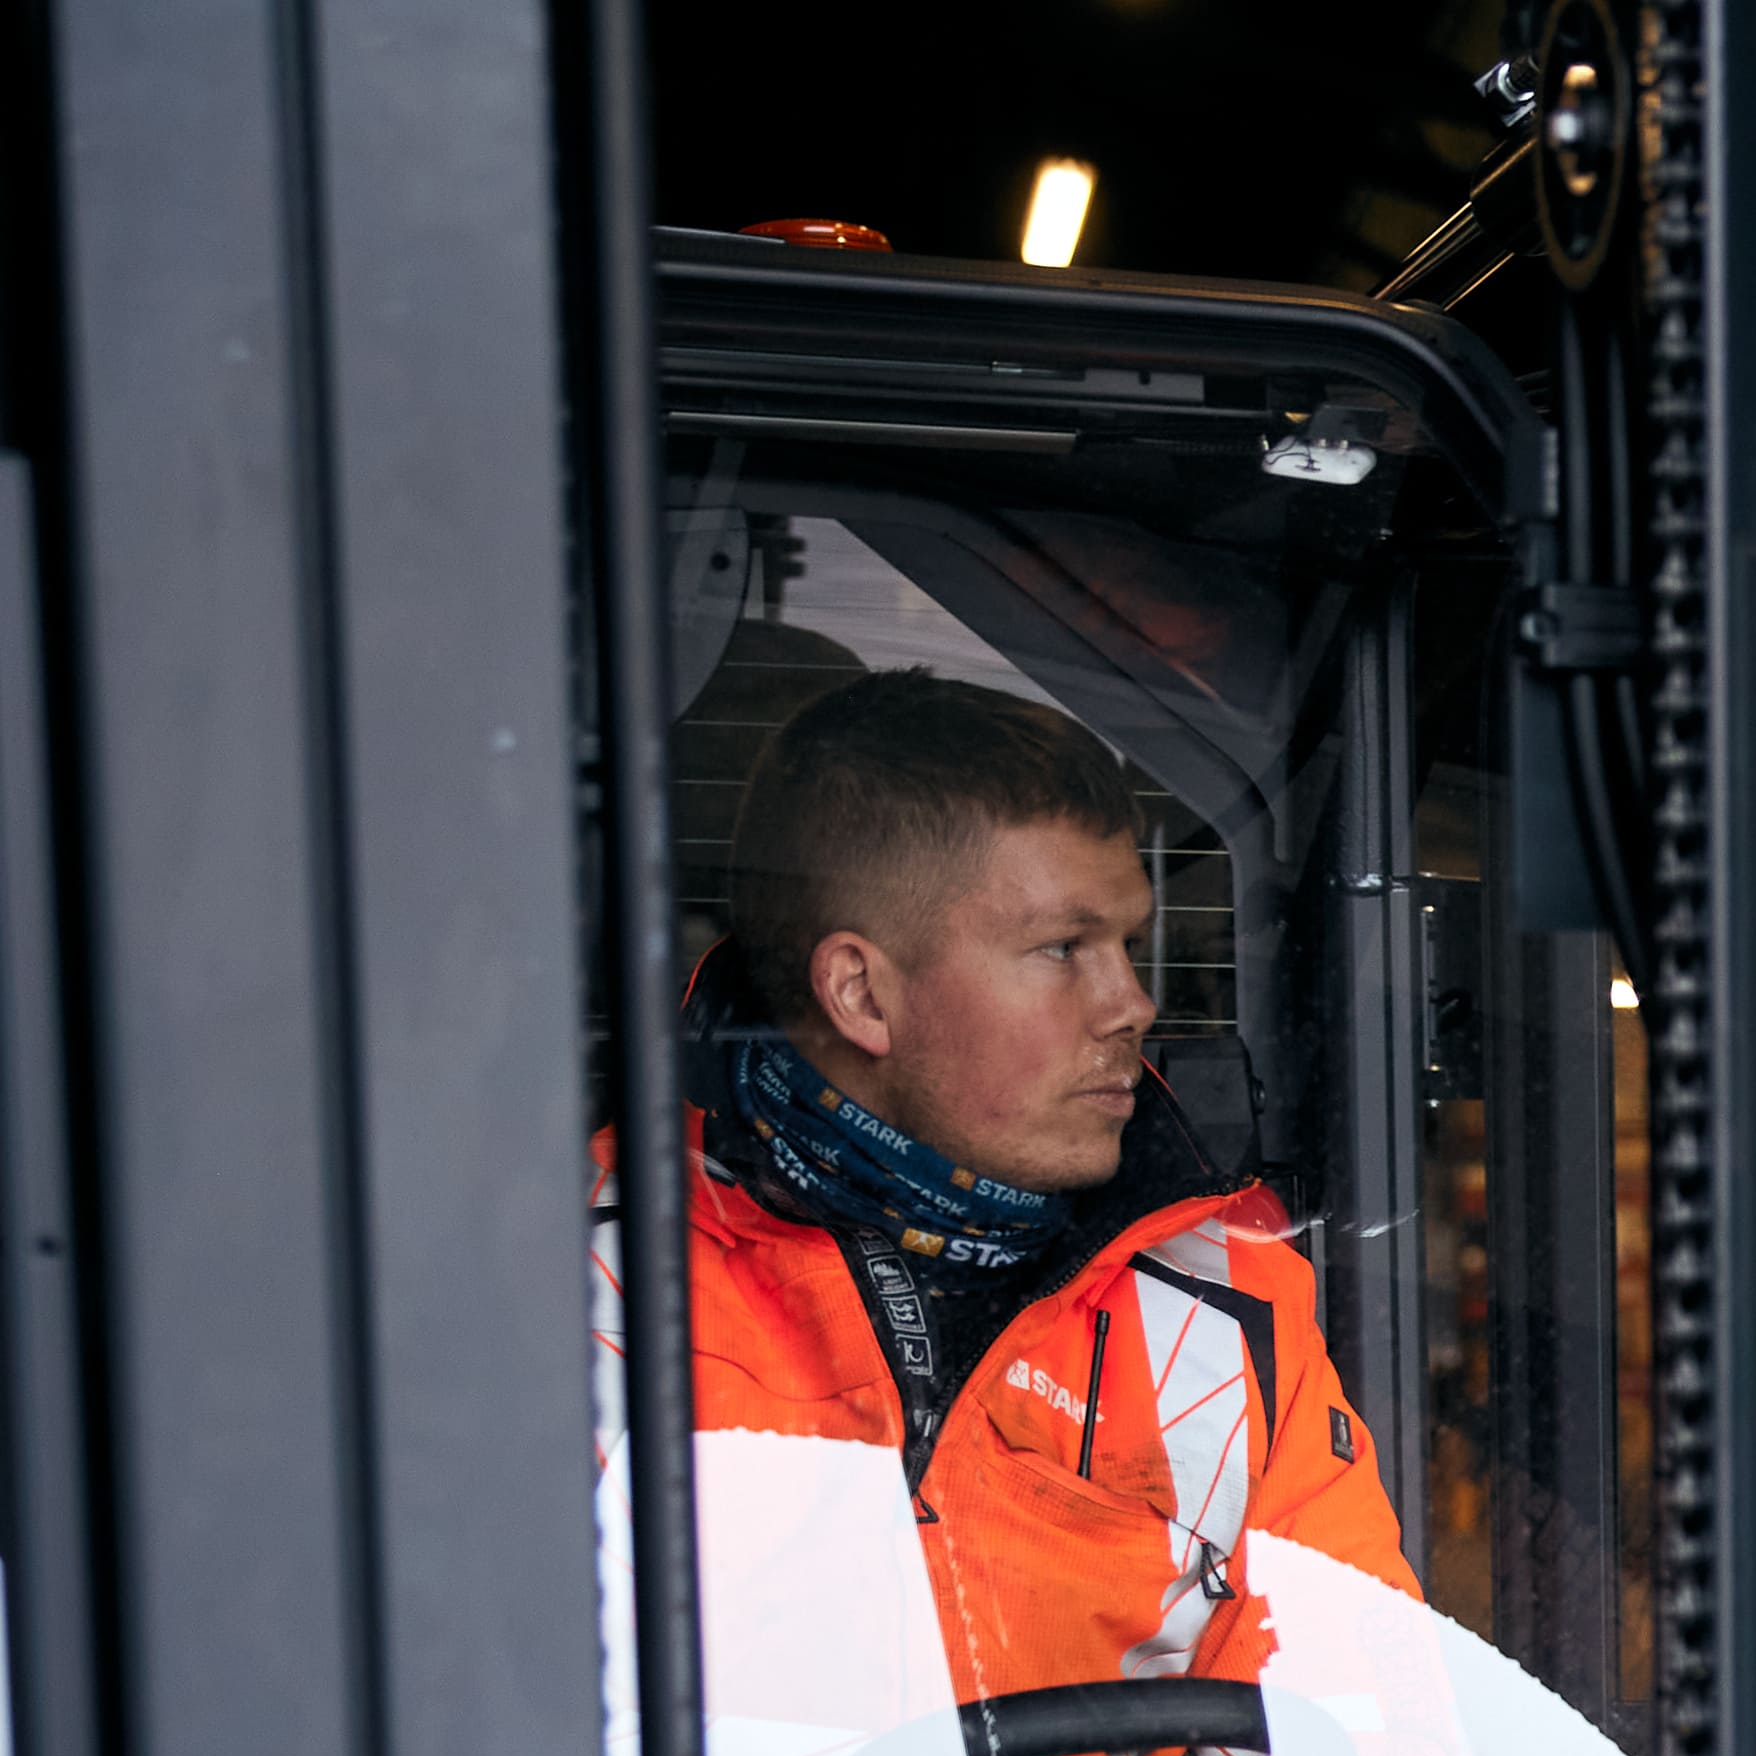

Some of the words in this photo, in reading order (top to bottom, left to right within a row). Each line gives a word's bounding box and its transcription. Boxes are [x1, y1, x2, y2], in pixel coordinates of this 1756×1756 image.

[839, 1103, 913, 1156] STARK
[975, 1178, 1047, 1209] STARK
[945, 1239, 1027, 1268] STA
